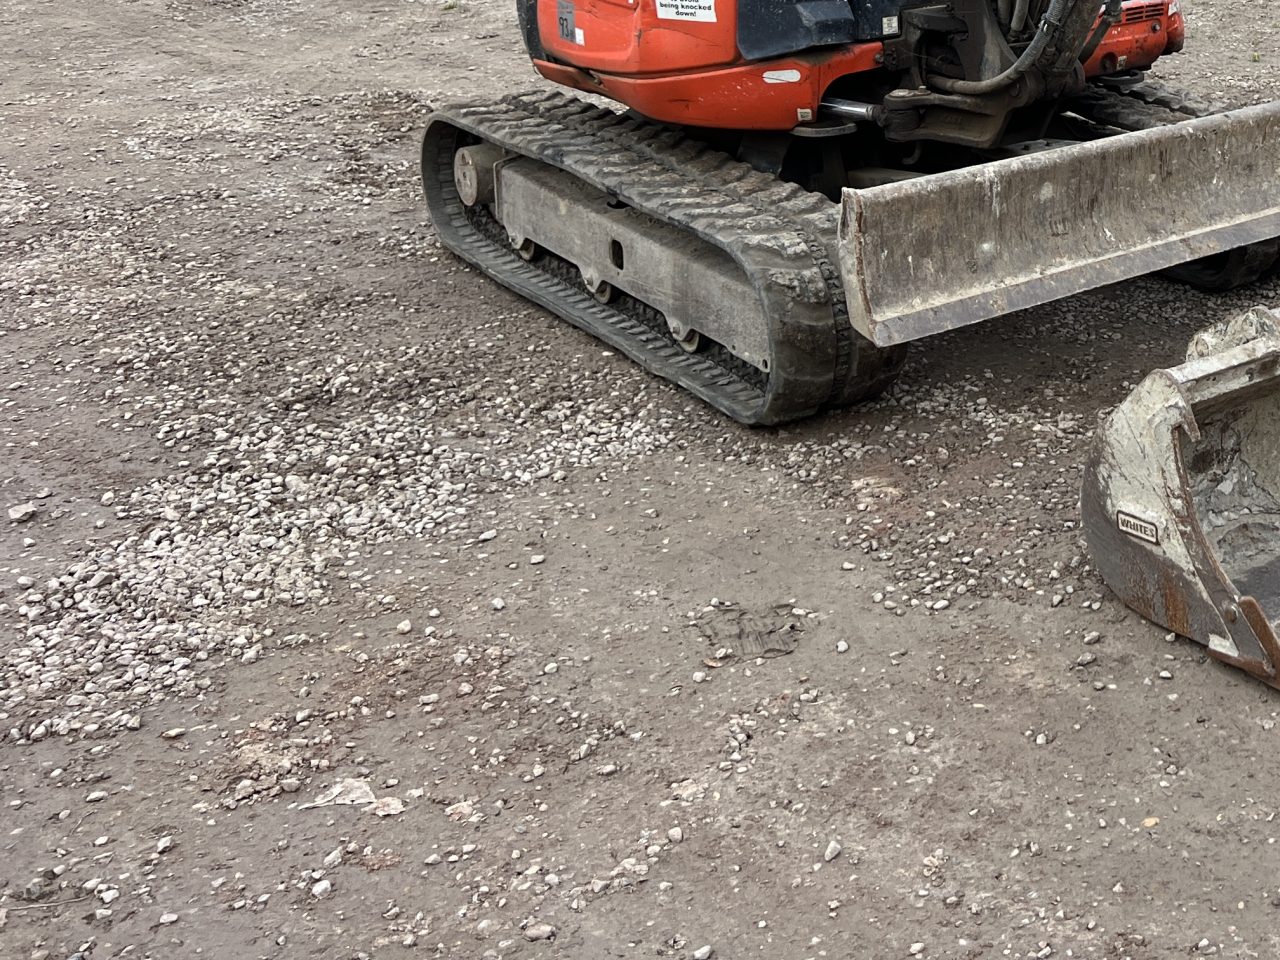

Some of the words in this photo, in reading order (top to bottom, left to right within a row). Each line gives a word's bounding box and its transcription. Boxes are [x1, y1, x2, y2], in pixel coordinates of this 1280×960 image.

[659, 1, 679, 11] being
[680, 3, 712, 11] knocked
[1120, 516, 1156, 539] WHITES
